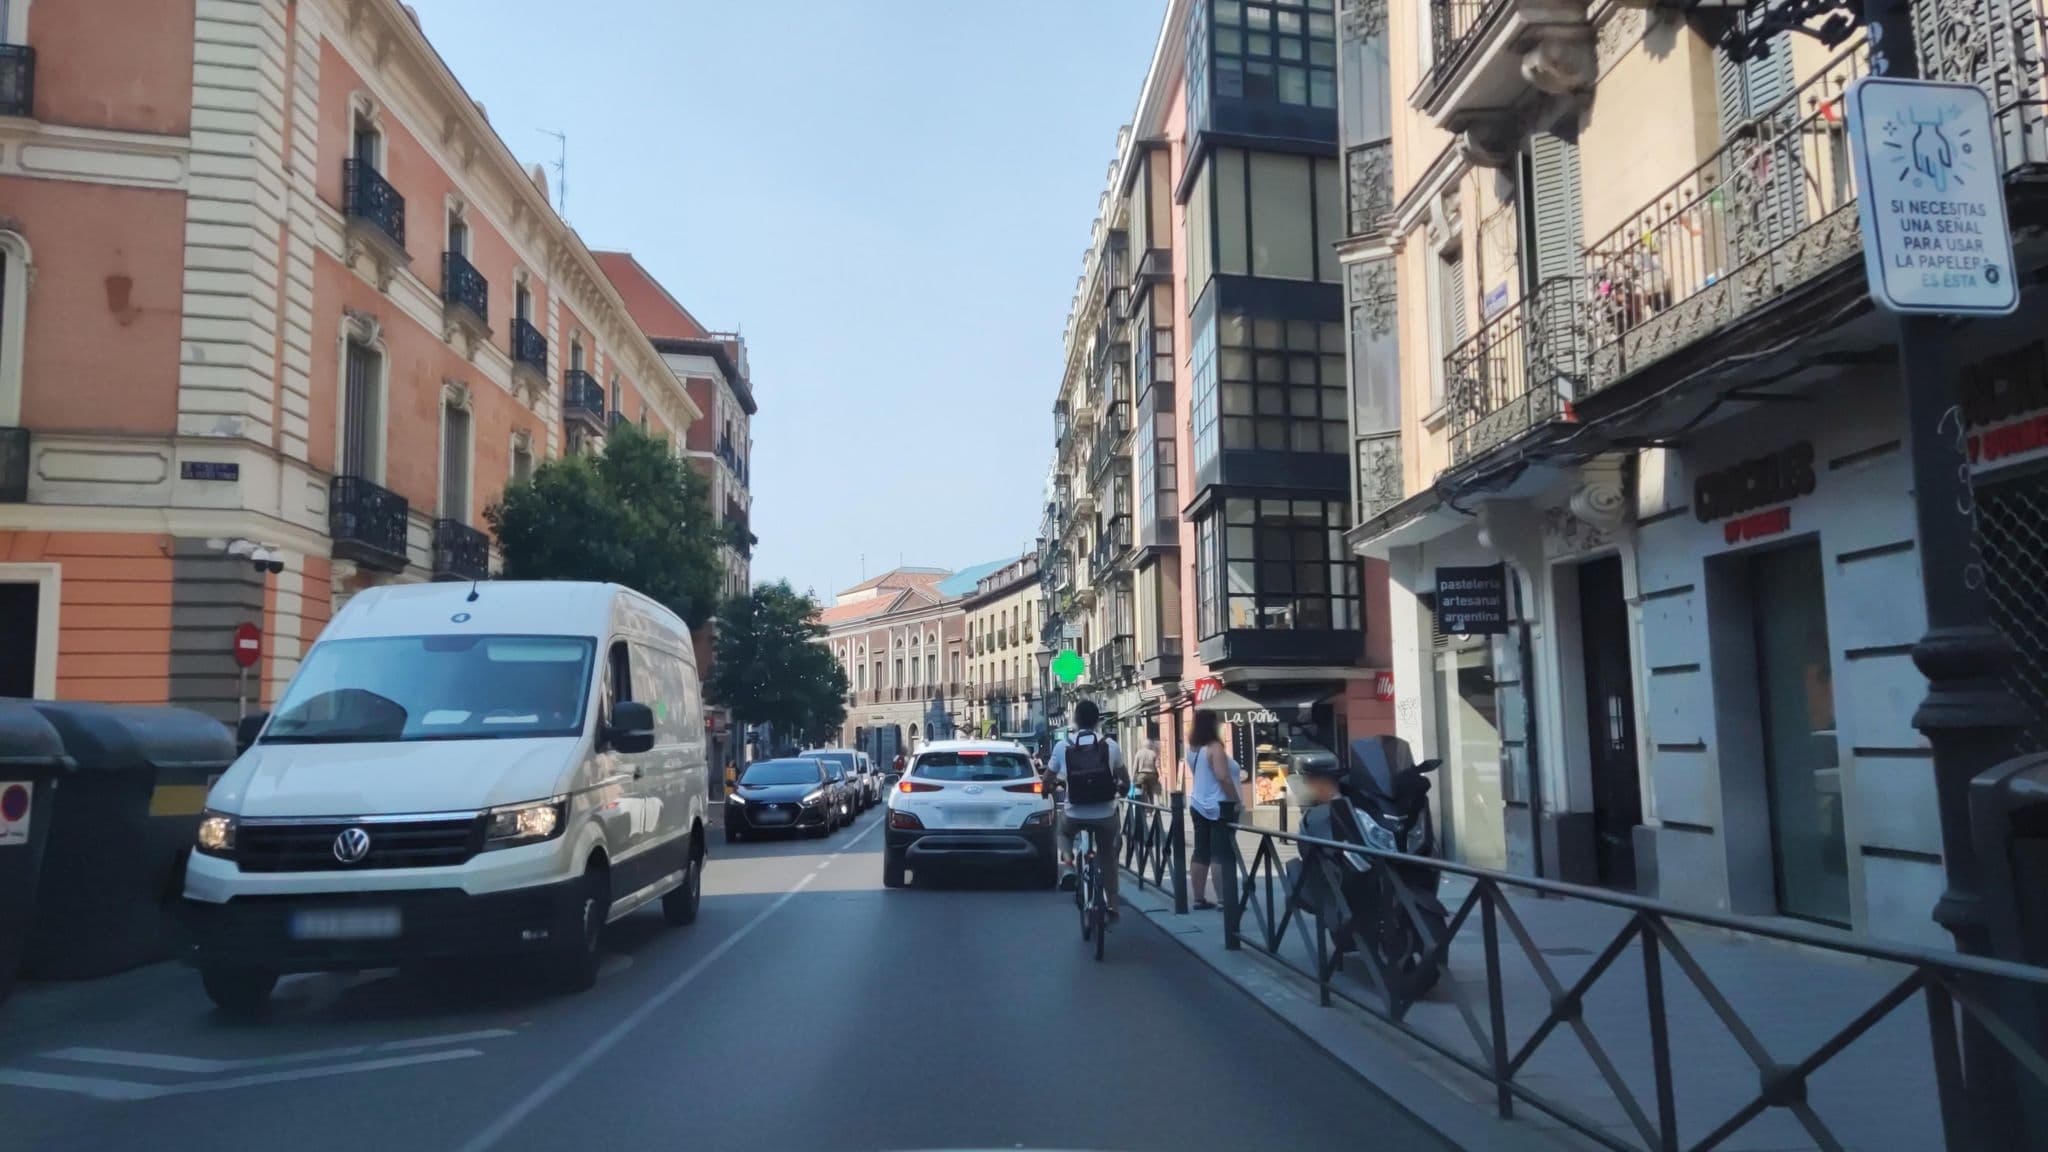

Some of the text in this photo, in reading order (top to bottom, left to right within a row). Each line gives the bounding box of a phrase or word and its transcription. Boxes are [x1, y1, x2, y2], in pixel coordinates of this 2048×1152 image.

[1891, 200, 1986, 217] SI NECESITAS
[1901, 217, 1982, 235] UNA SEÑAL
[1904, 236, 1984, 252] PARA USAR
[1896, 254, 1989, 270] LA PAPELER
[1442, 596, 1500, 607] artesanal
[1445, 611, 1500, 626] argentina
[1224, 709, 1280, 723] La Doña
